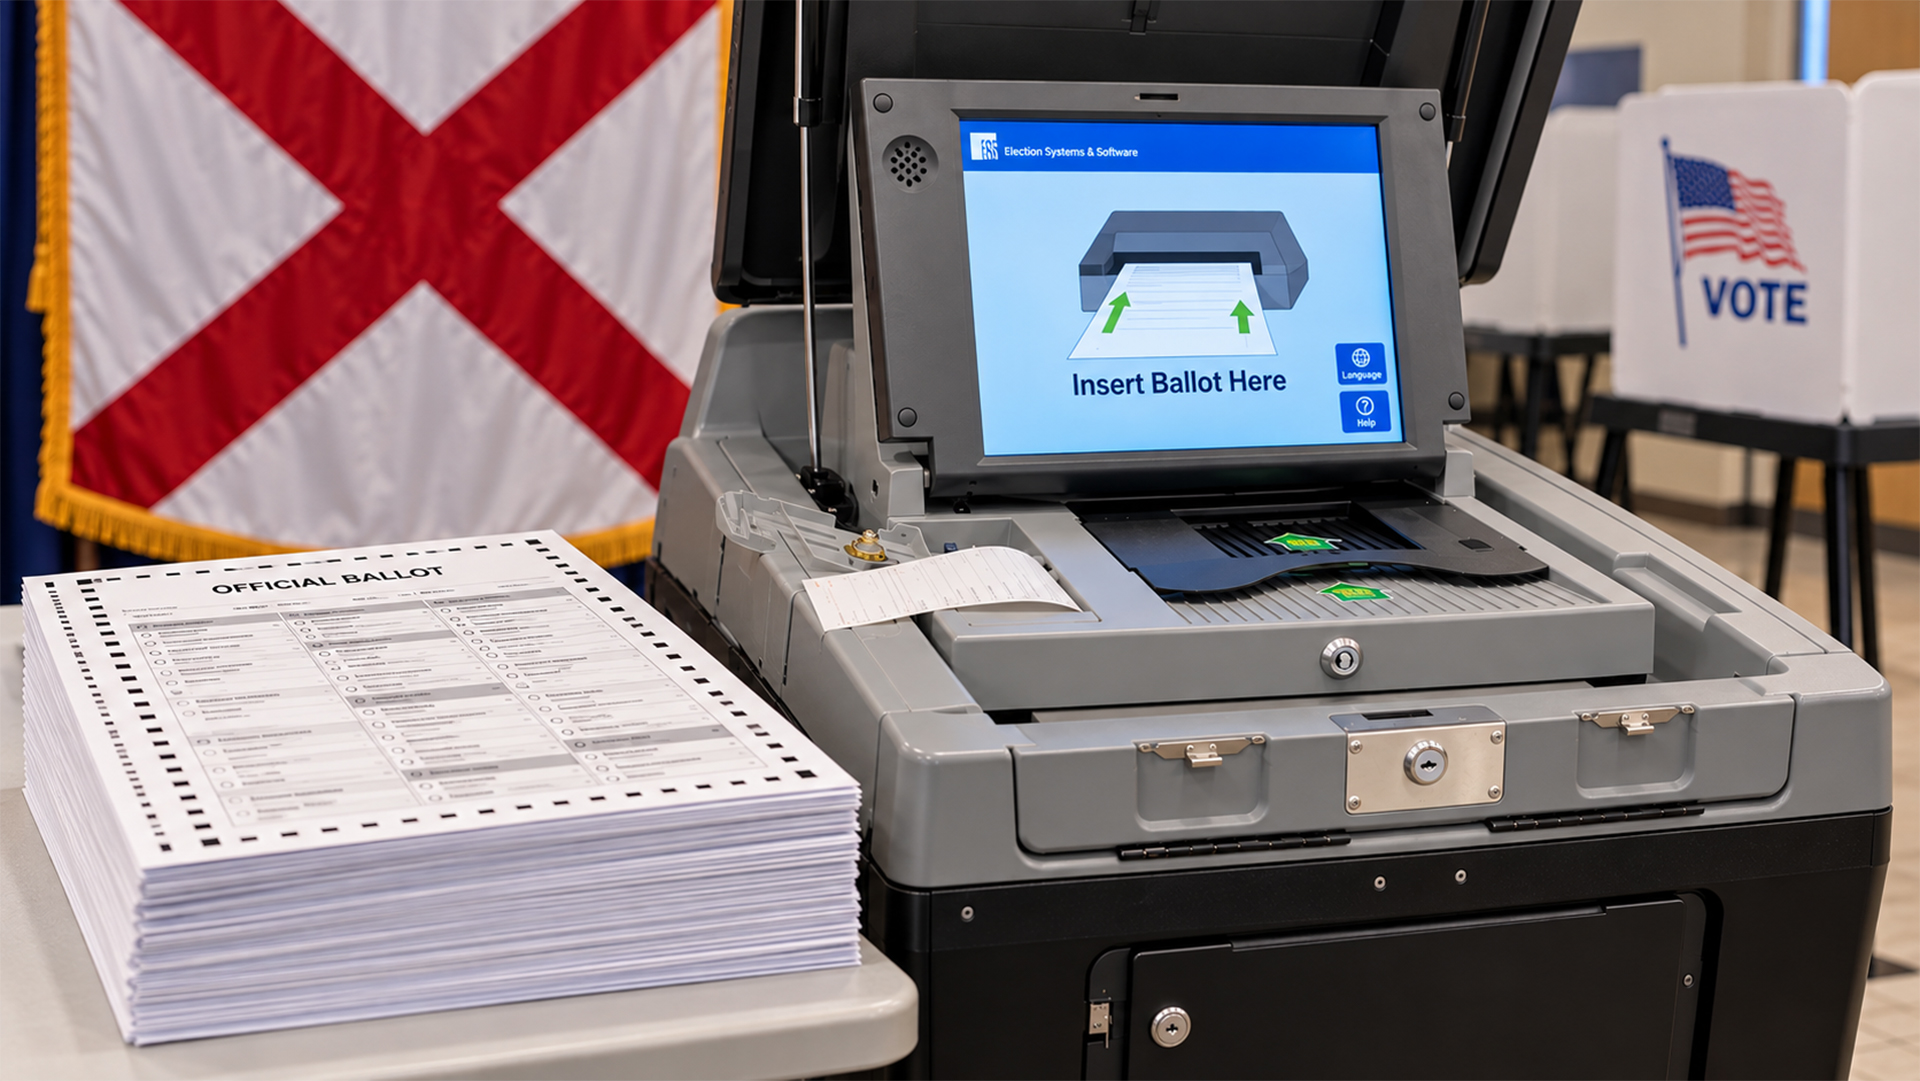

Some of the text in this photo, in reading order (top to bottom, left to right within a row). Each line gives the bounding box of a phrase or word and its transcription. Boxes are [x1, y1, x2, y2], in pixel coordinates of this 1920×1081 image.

[1004, 146, 1139, 159] Election Systems & Software
[1702, 276, 1808, 325] VOTE
[1072, 369, 1288, 396] Insert Ballot Here
[1341, 371, 1383, 381] Language
[1357, 417, 1377, 429] Help
[211, 566, 444, 594] OFFICIAL BALLOT
